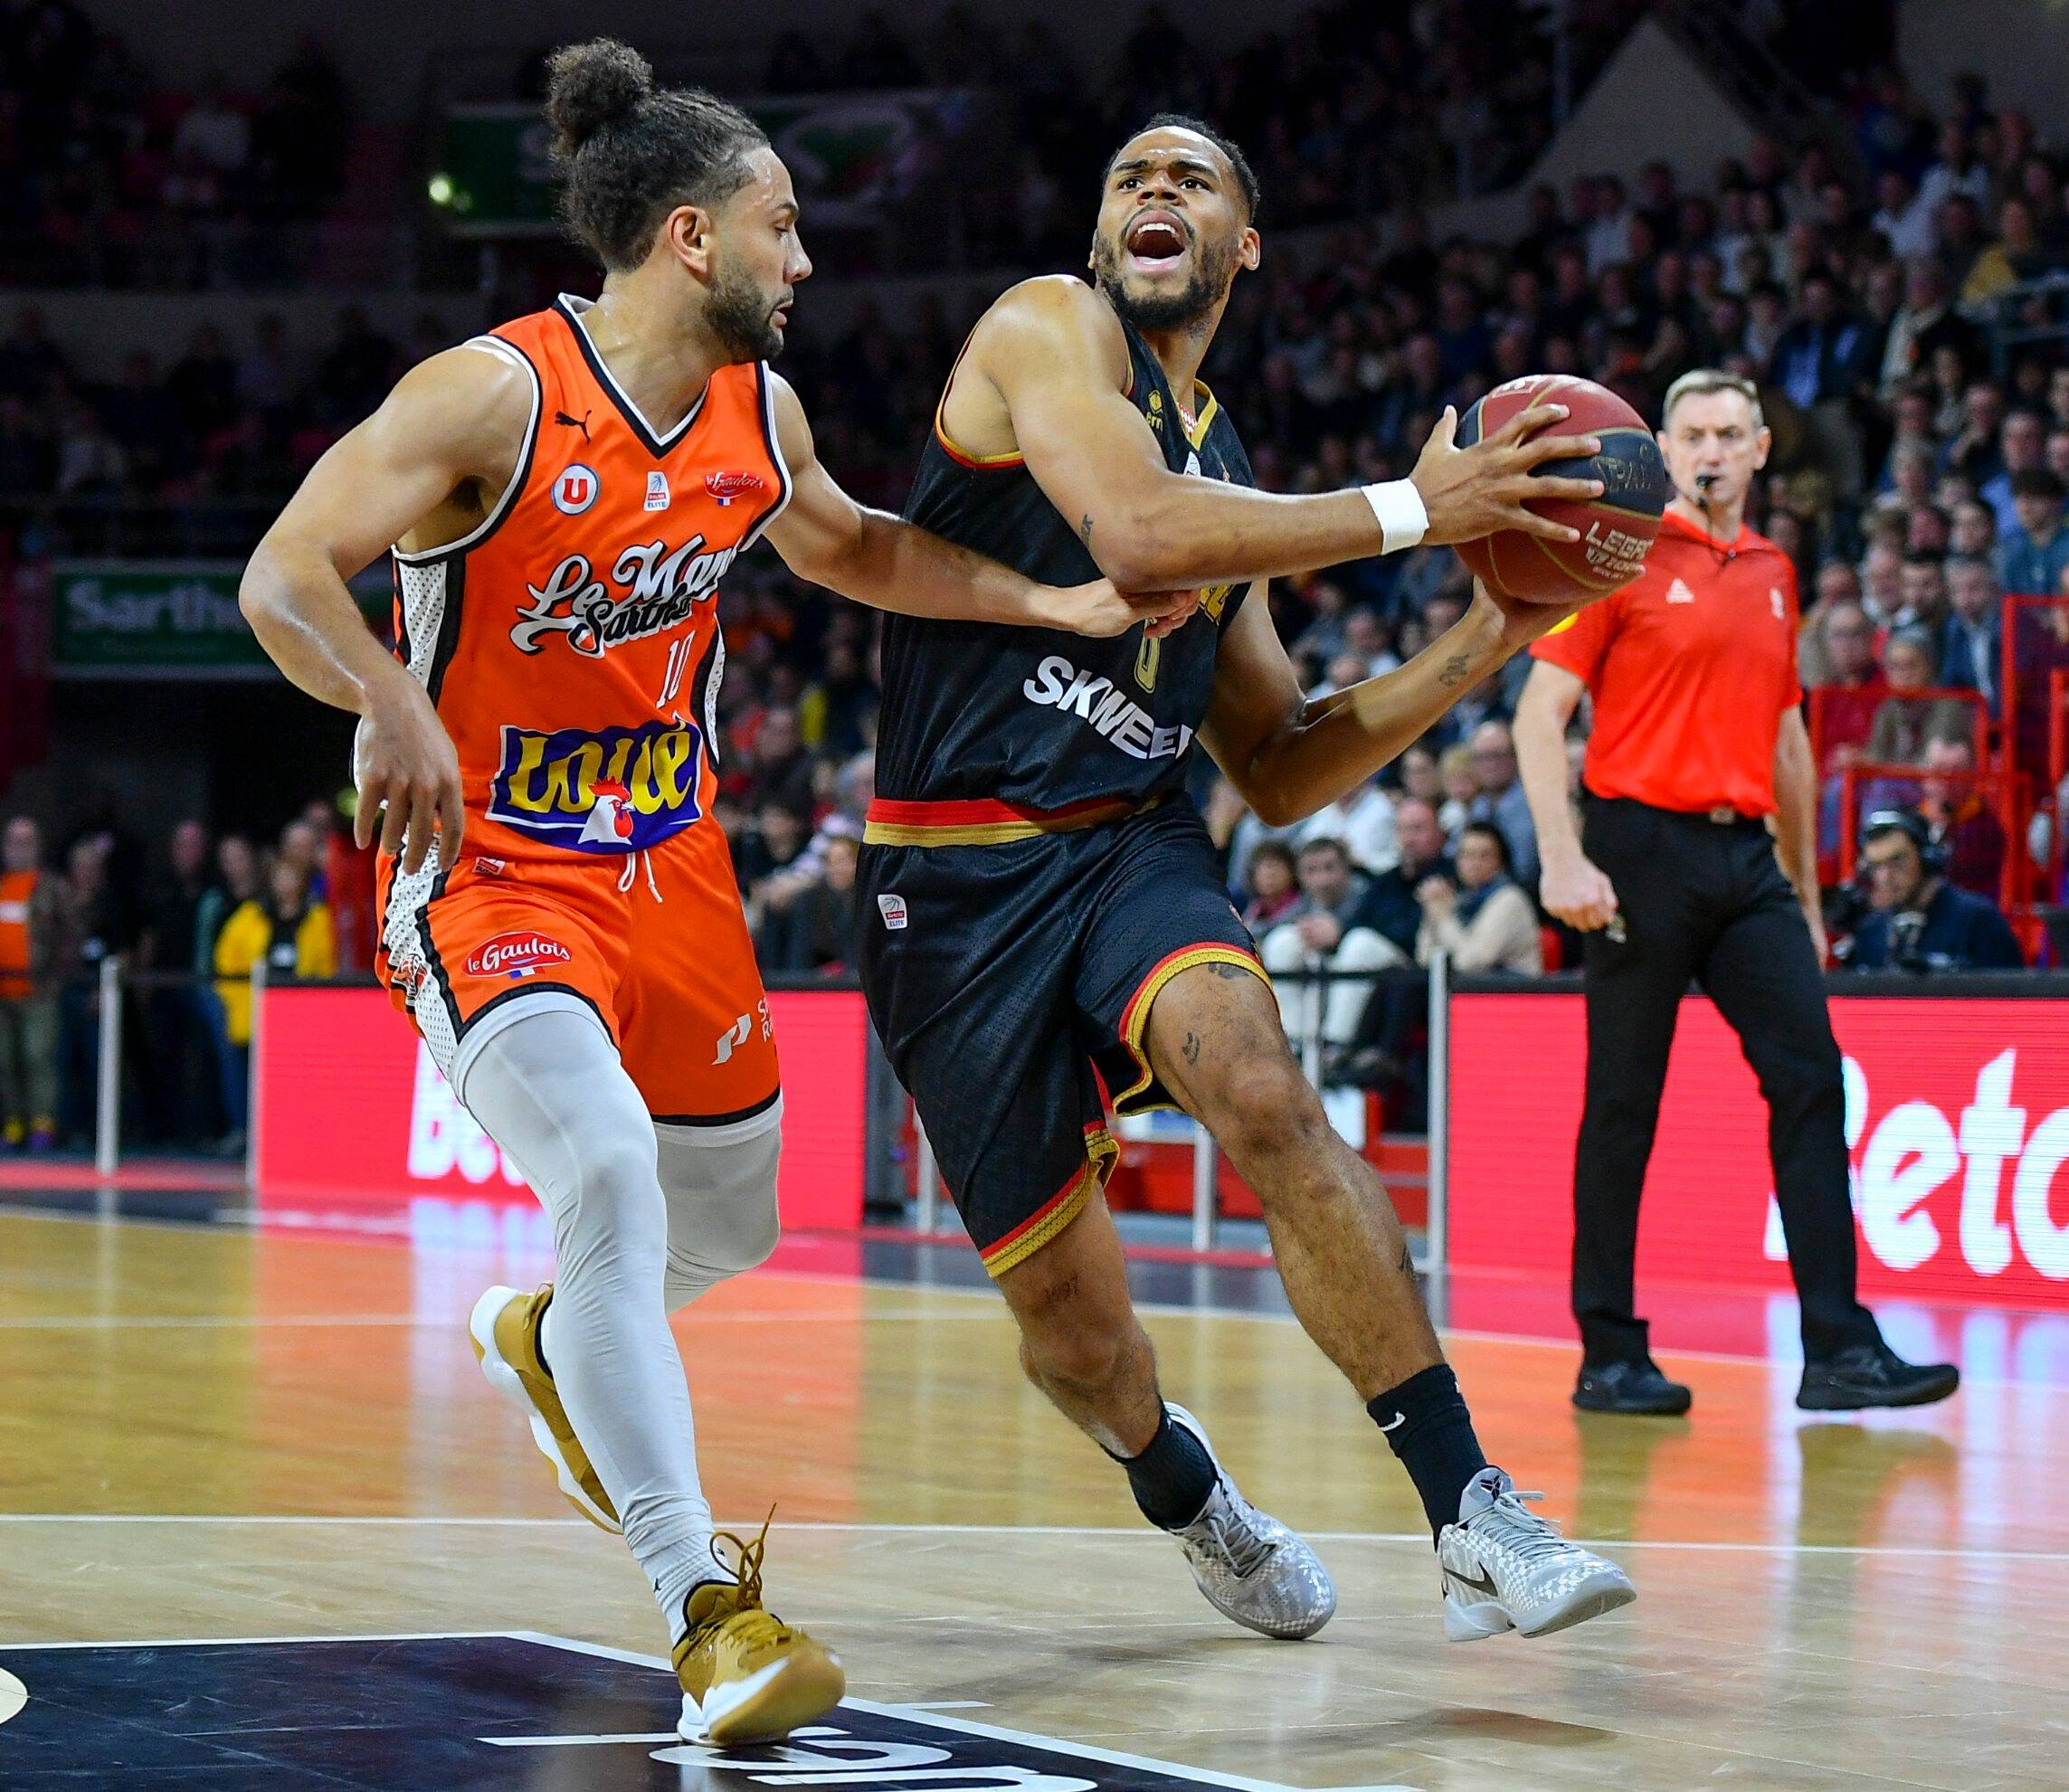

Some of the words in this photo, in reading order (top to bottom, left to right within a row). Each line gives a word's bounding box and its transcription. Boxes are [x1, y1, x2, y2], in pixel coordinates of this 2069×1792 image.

[563, 479, 588, 504] U
[509, 554, 608, 656] Le
[656, 630, 696, 709] 10
[467, 956, 480, 973] le
[481, 937, 571, 972] Gaulois
